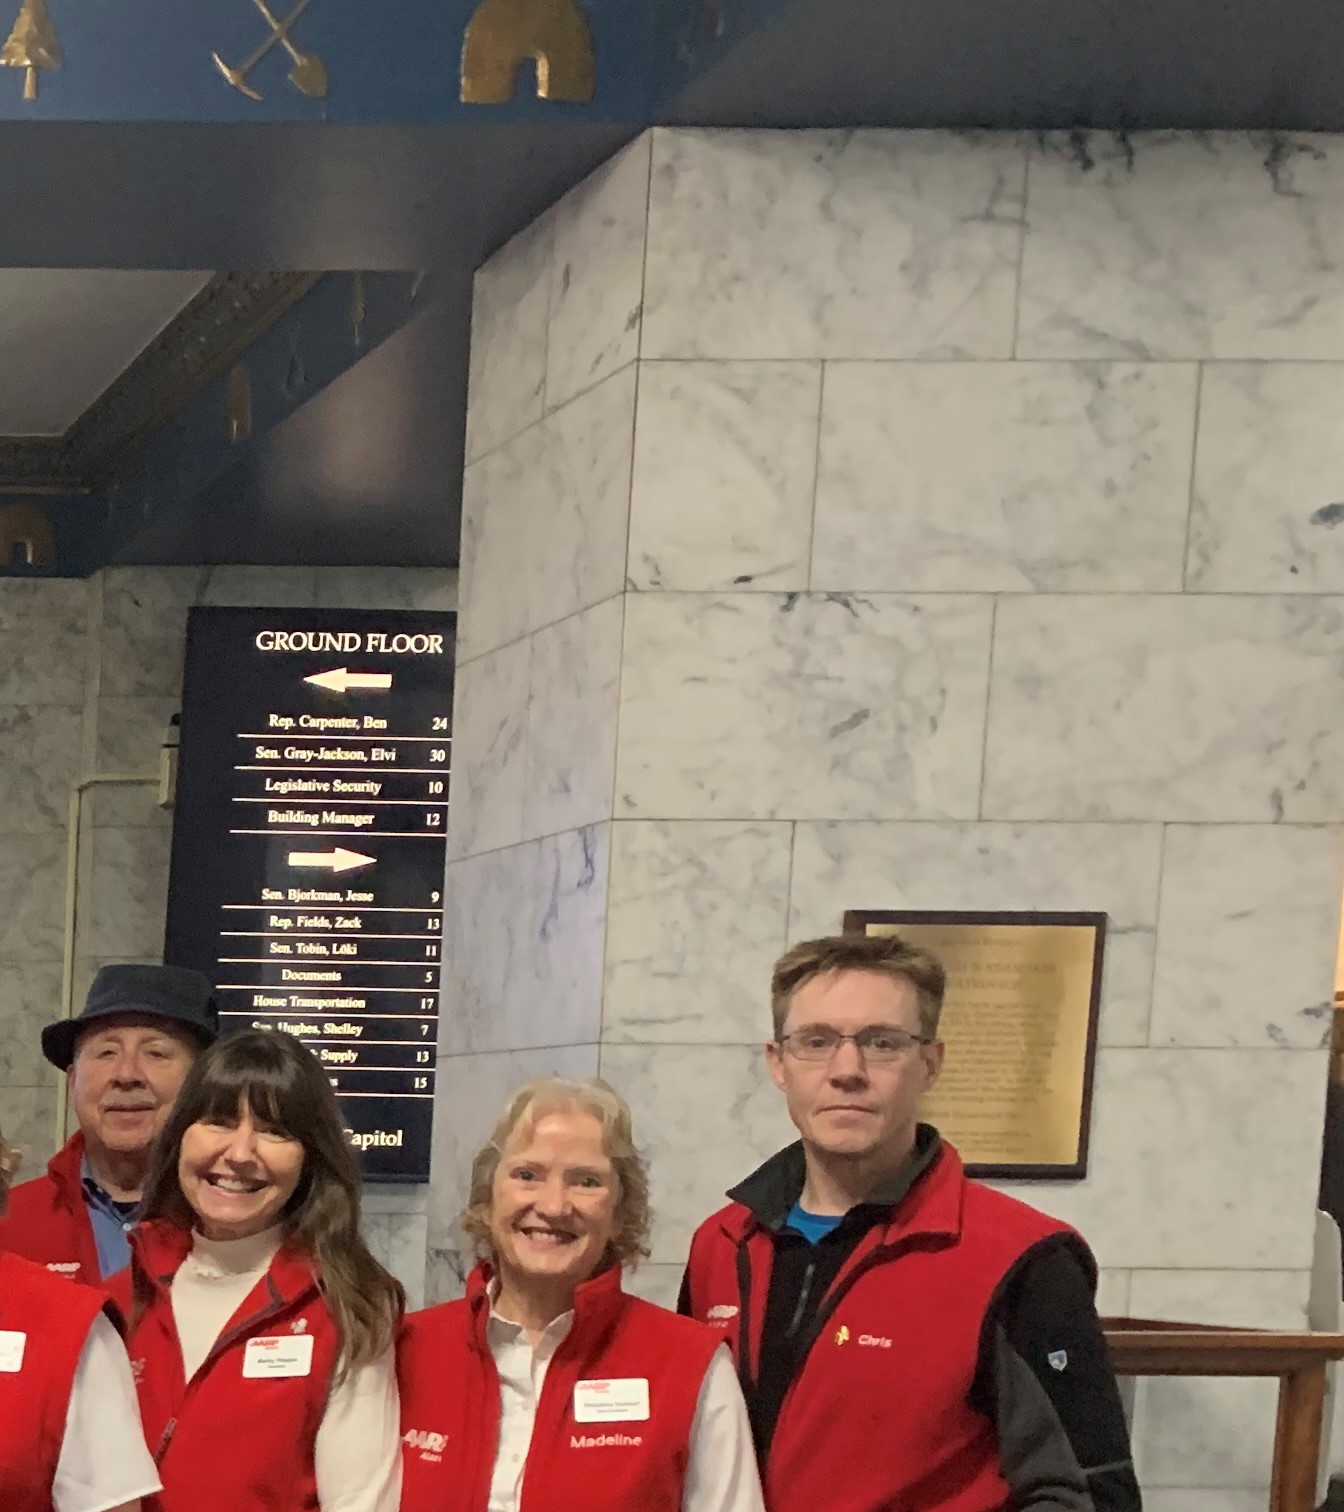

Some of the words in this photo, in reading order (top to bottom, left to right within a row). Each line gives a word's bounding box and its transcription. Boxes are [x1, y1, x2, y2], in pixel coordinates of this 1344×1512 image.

[255, 630, 361, 652] GROUND
[366, 633, 443, 654] FLOOR
[269, 714, 296, 730] Rep.
[299, 714, 360, 731] Carpenter,
[363, 716, 387, 730] Ben
[431, 717, 448, 731] 24
[255, 745, 281, 760] Sen.
[284, 746, 368, 763] Gray-Jackson,
[371, 747, 397, 762] Elvi
[429, 749, 446, 763] 30
[265, 778, 330, 795] Legislative
[332, 779, 382, 796] Security
[428, 780, 444, 795] 10
[267, 809, 320, 827] Building
[321, 811, 375, 827] Manager
[426, 812, 441, 827] 12
[262, 888, 285, 901] Sen.
[288, 889, 343, 903] Bjorkman,
[345, 890, 375, 903] Jesse
[431, 891, 440, 903] 9
[269, 915, 294, 930] Rep.
[296, 916, 332, 930] Fields,
[334, 916, 362, 929] Zack
[427, 918, 440, 931] 13
[269, 942, 293, 955] Sen.
[296, 943, 330, 956] Tobin,
[425, 945, 437, 957] 11
[281, 969, 342, 982] Documents
[424, 971, 433, 983] 5
[253, 995, 287, 1007] House
[289, 996, 366, 1011] Transportation
[420, 998, 434, 1010] 17
[323, 1023, 363, 1038] Shelley
[420, 1024, 429, 1036] 7
[320, 1049, 358, 1064] Supply
[416, 1051, 430, 1063] 13
[414, 1077, 428, 1089] 15
[858, 1334, 893, 1349] Chris
[570, 1433, 643, 1449] Madeline
